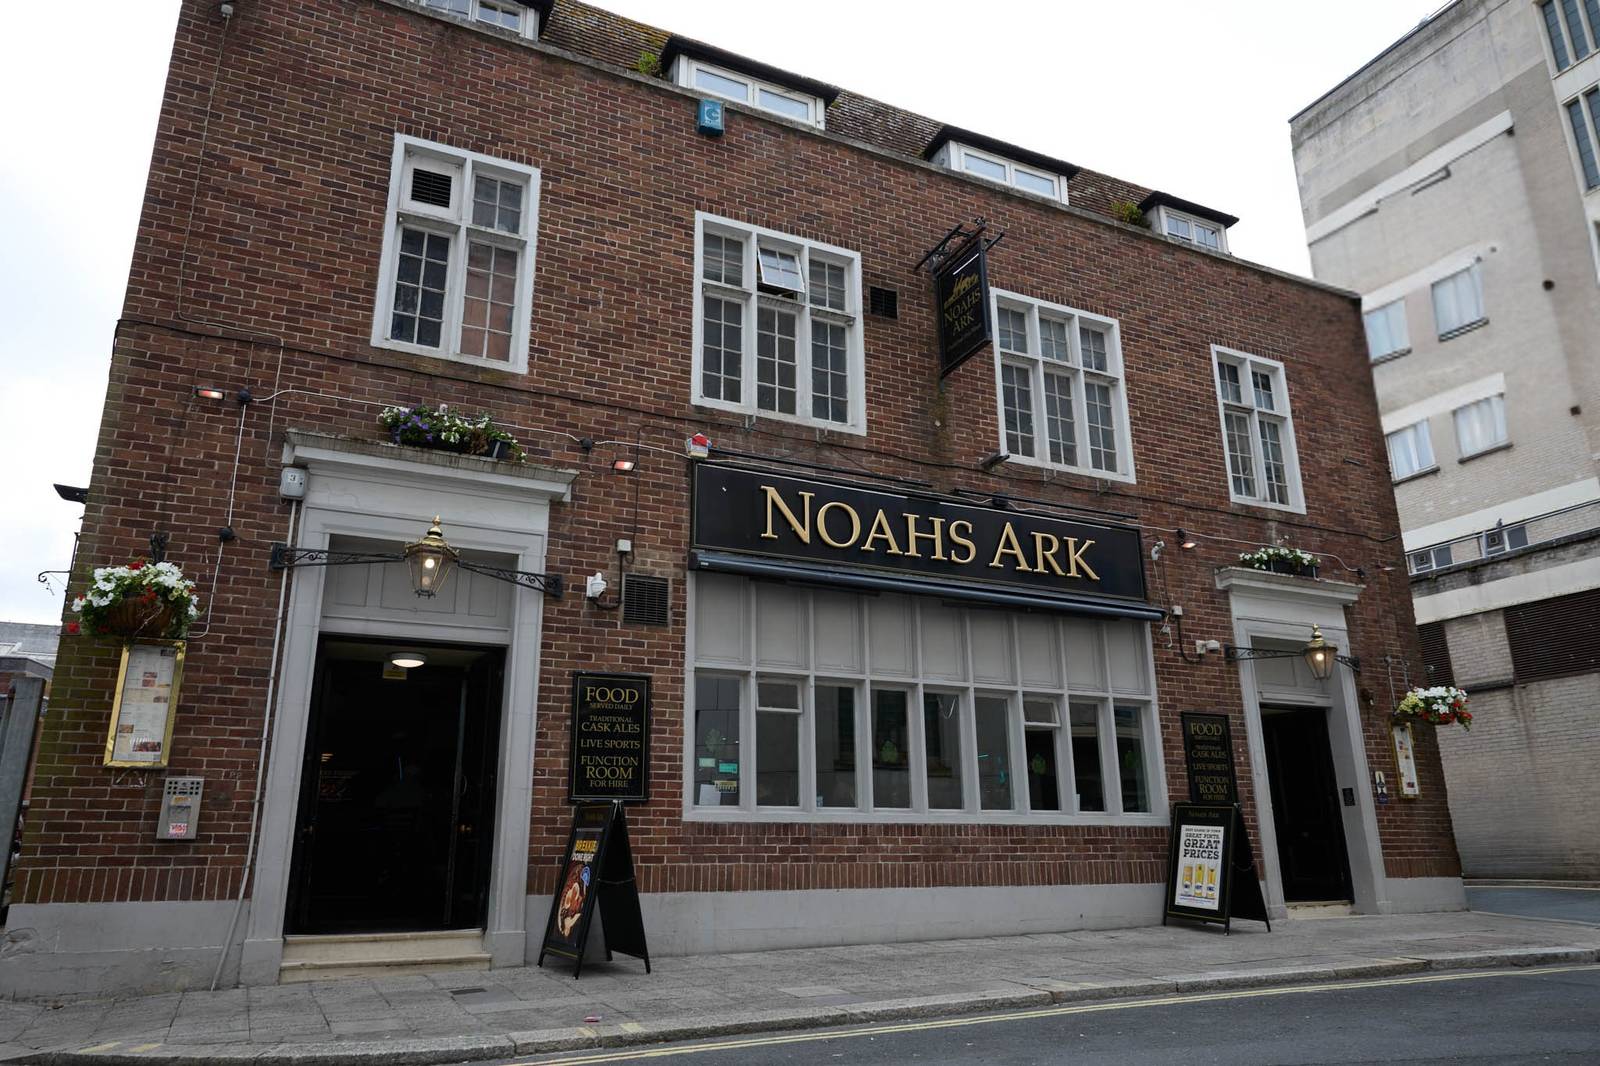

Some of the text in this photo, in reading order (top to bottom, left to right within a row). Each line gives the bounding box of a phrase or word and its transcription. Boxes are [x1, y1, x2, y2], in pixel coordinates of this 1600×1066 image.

[944, 288, 981, 326] NOAHS
[952, 311, 975, 336] ARK
[760, 485, 1100, 581] NOAHS ARK
[585, 687, 639, 704] FOOD
[614, 703, 633, 711] DAILY
[589, 715, 632, 723] TRADITIONAL
[581, 722, 640, 733] CASK ALES
[1190, 722, 1222, 735] FOOD
[580, 739, 640, 749] LIVE SPORTS
[580, 755, 639, 766] FUNCTION
[585, 766, 632, 779] ROOM
[590, 780, 629, 788] FOR HIRE
[1199, 784, 1228, 794] ROOM
[1184, 839, 1220, 849] GREAT
[1183, 849, 1219, 860] PRICES
